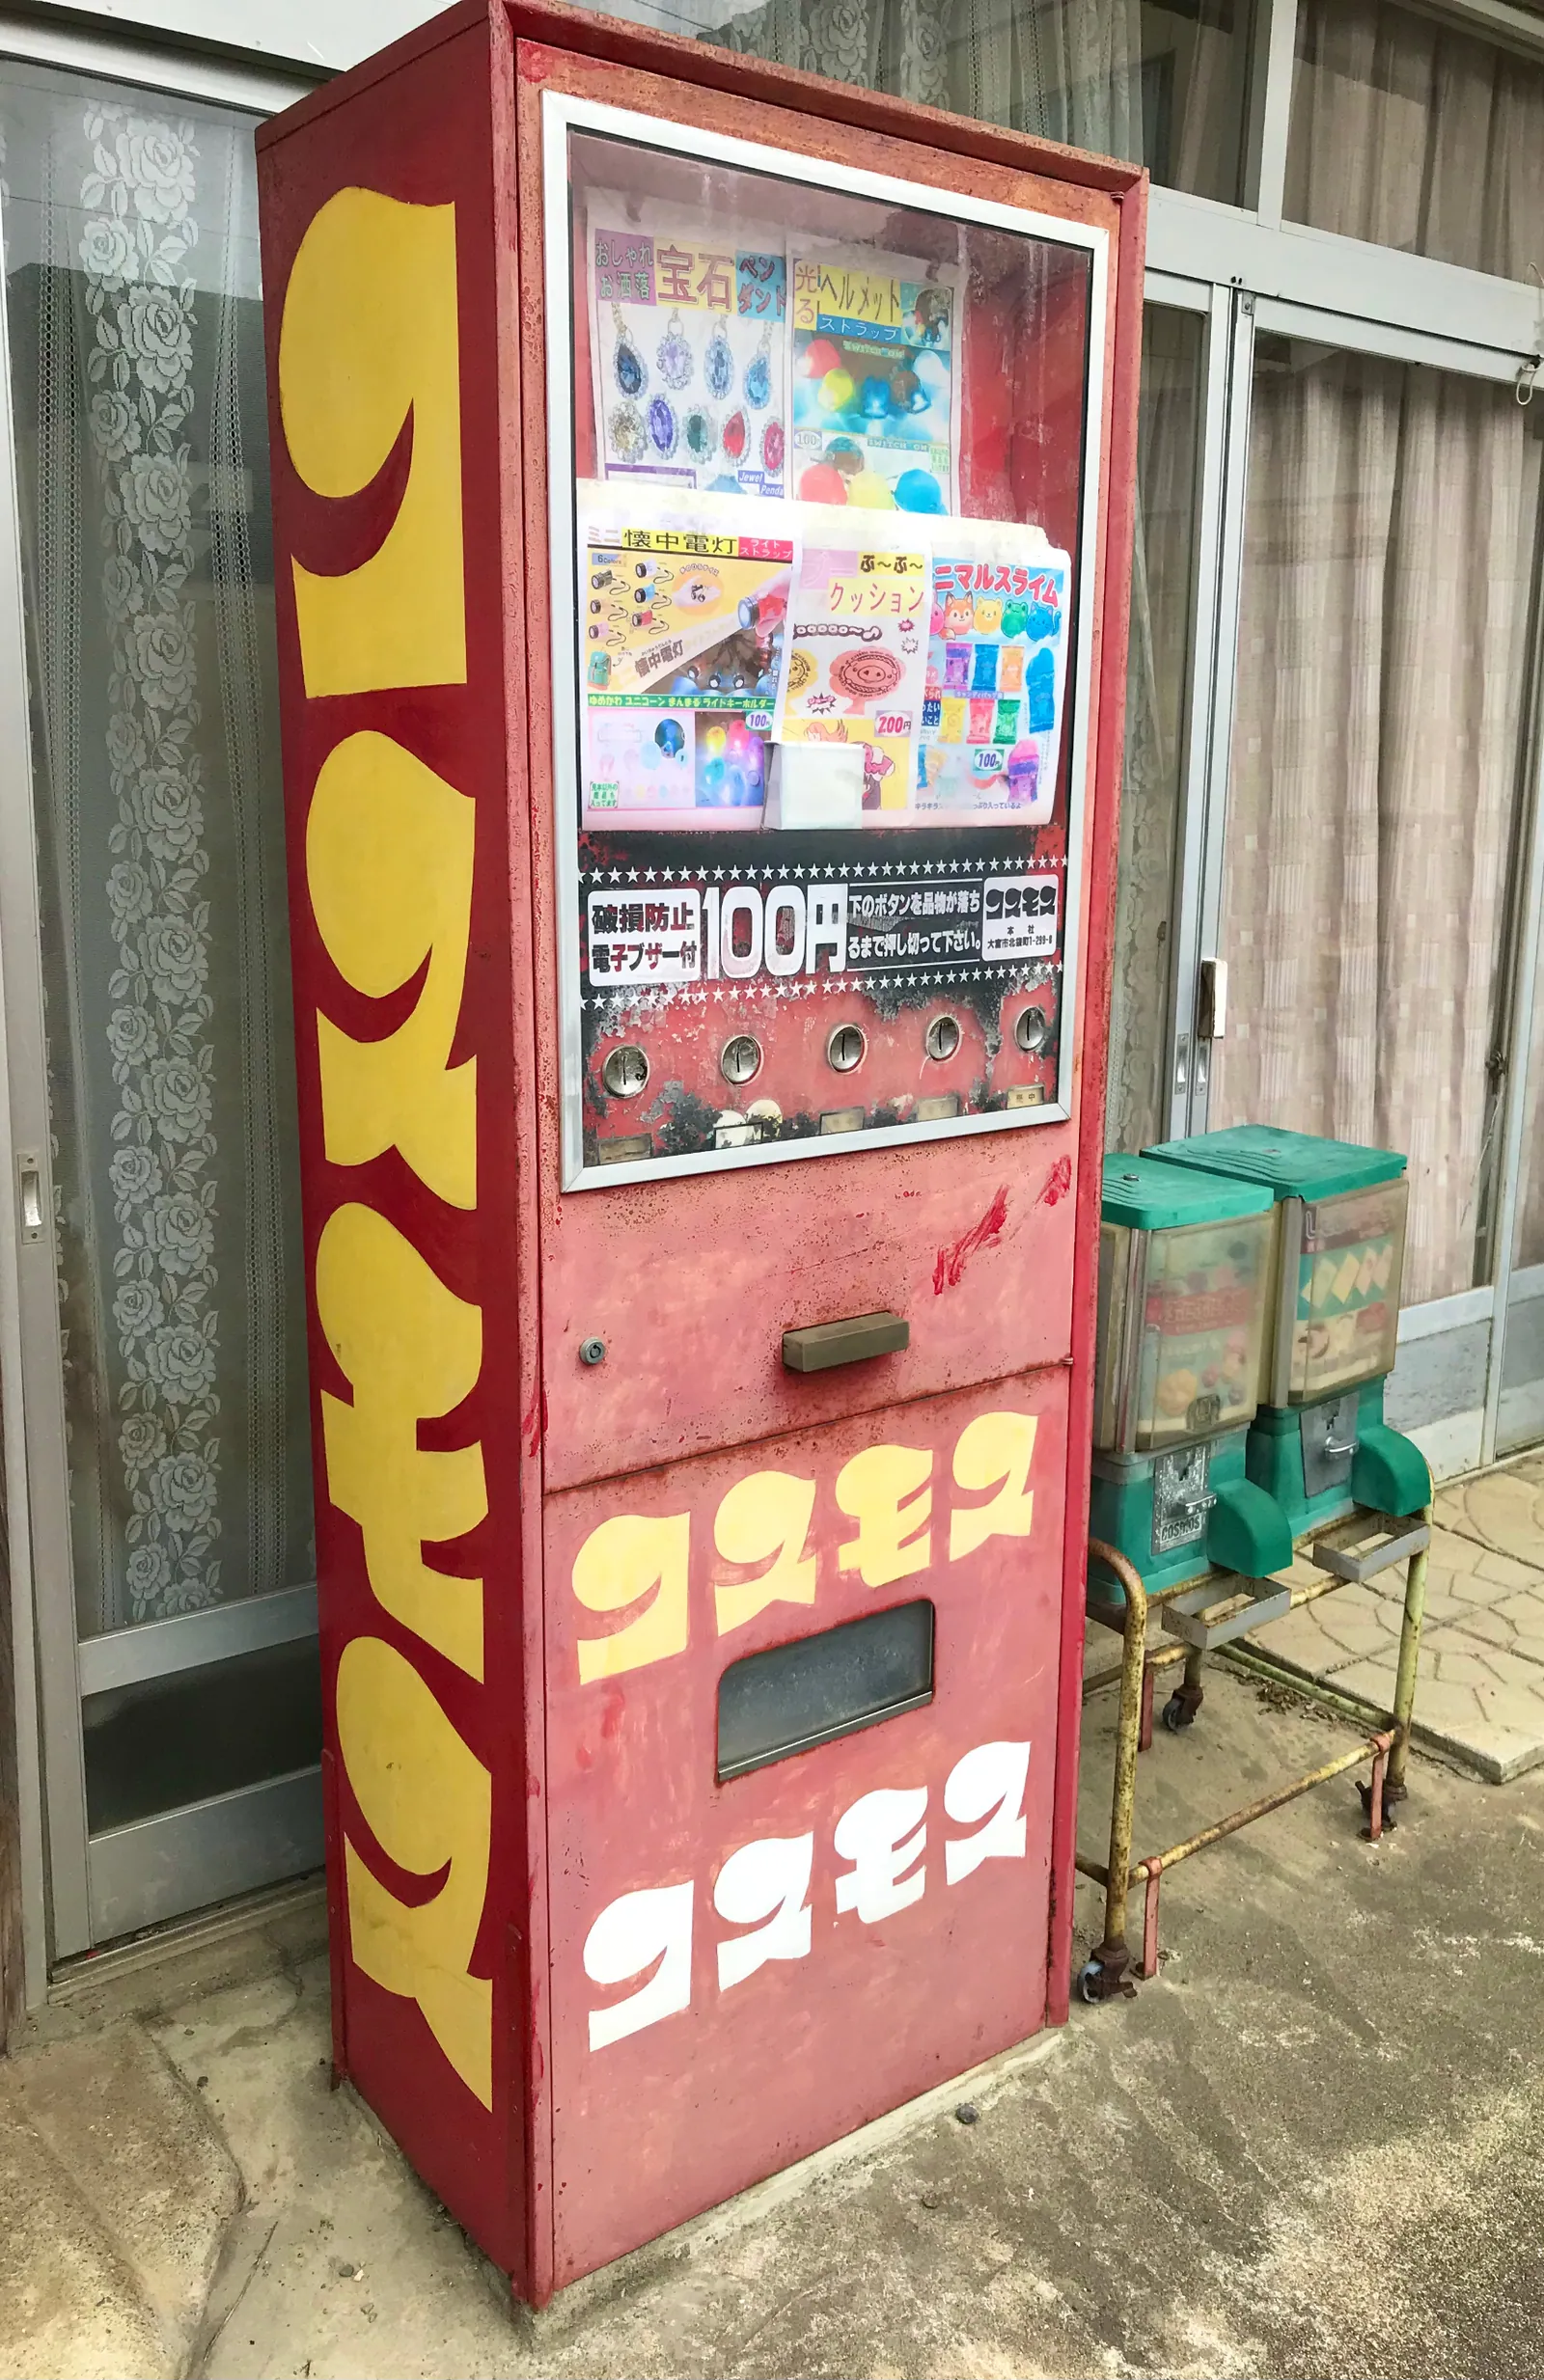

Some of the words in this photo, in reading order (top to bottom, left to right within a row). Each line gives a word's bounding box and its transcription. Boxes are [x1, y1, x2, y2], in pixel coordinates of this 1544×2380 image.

[595, 239, 653, 267] おしゃれ
[657, 244, 734, 313] 宝石
[739, 256, 775, 283] ペン
[600, 271, 650, 301] お洒落
[820, 273, 899, 322] ヘルメット
[819, 317, 899, 341] ストラップ
[739, 472, 763, 482] Jewel
[624, 529, 736, 555] 懐中電灯
[739, 547, 792, 561] ストラップ
[751, 537, 780, 549] ライト
[830, 583, 924, 614] クッション
[878, 716, 912, 733] 200円
[848, 889, 980, 918] 下のボタンを品物が落ち
[985, 885, 1057, 920] コスモス
[592, 902, 695, 934] 破損防止
[702, 883, 848, 980] 100円
[592, 940, 698, 972] 電子ブザー付
[848, 928, 981, 959] るまで押し切って下さい。
